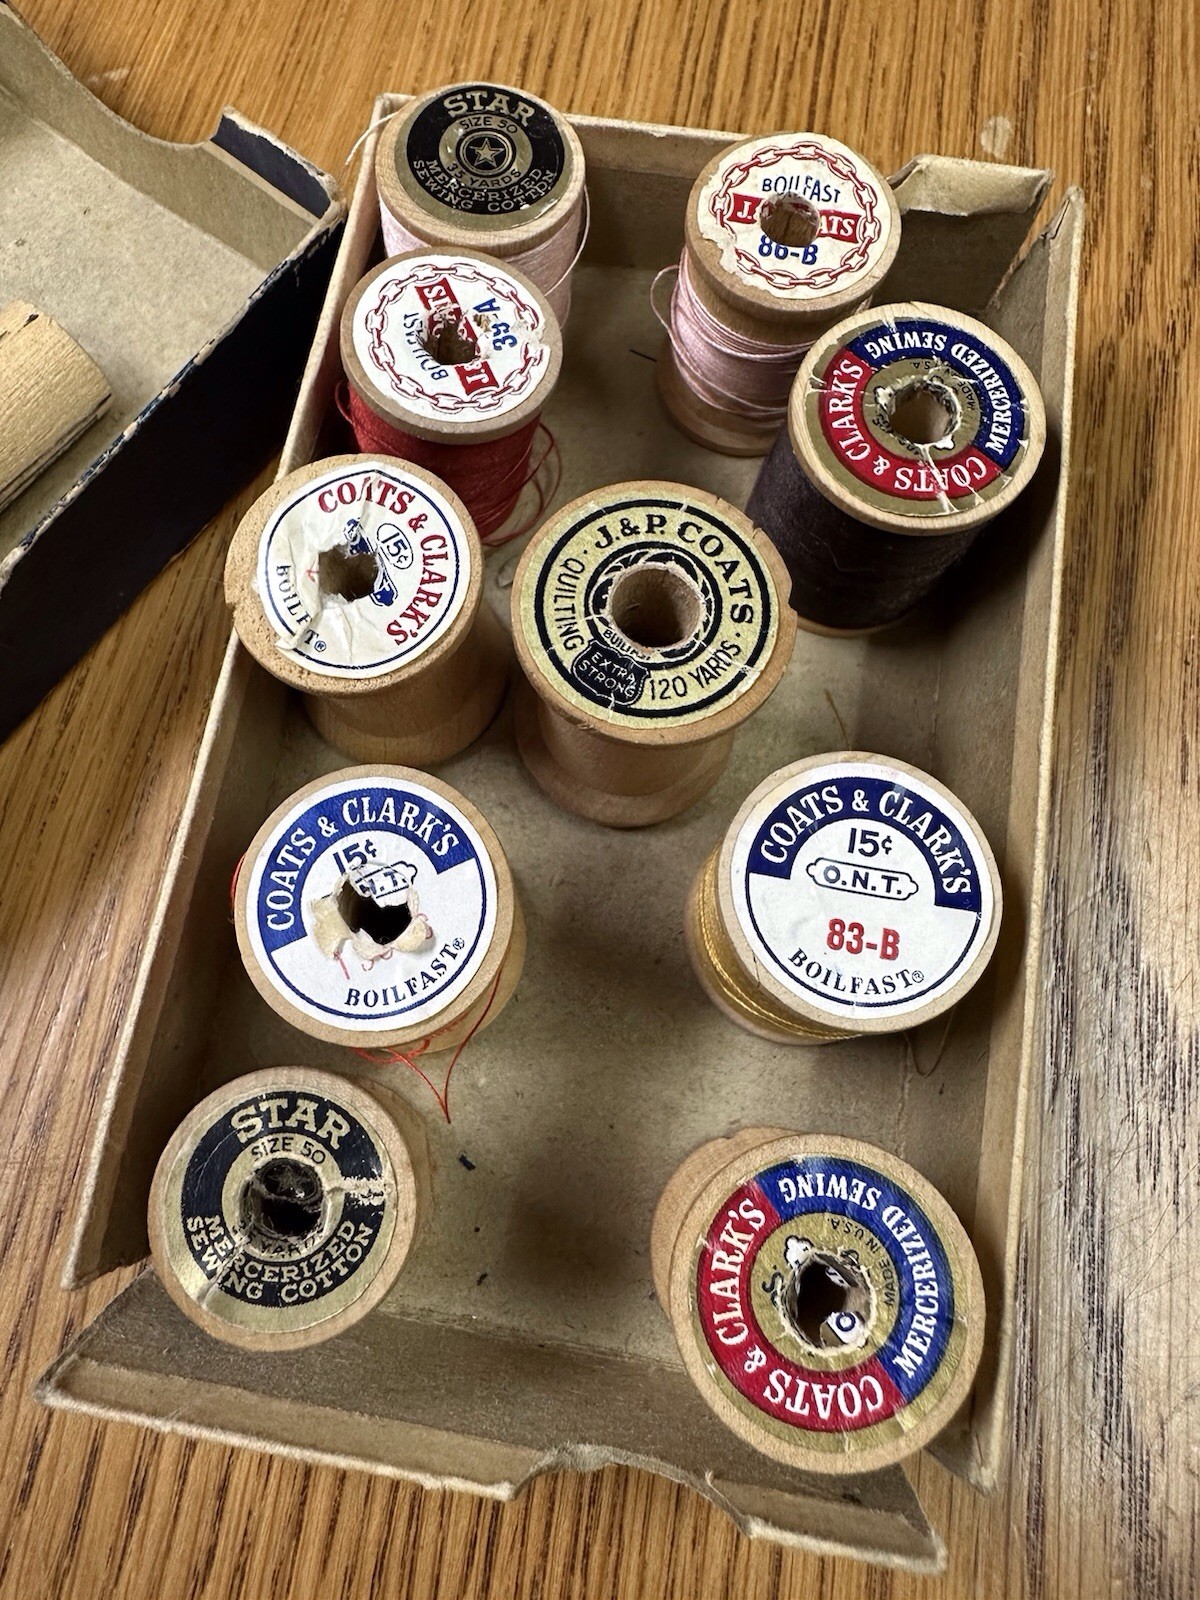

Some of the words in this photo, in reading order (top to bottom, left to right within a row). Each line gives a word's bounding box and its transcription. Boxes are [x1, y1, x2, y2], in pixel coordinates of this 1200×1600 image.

[443, 90, 536, 127] STAR
[459, 116, 492, 130] SIZE
[497, 119, 518, 134] 50
[412, 159, 474, 209] SEWING
[487, 169, 558, 212] COTTON
[426, 159, 543, 201] MERCERIZED
[469, 167, 522, 188] YARDS
[863, 330, 948, 360] SEWING
[828, 358, 871, 462] CLARK'S
[950, 343, 1012, 455] MERCERIZED
[872, 455, 891, 476] &
[893, 456, 987, 492] COATS
[317, 475, 416, 514] COATS
[408, 512, 428, 534] &
[386, 534, 450, 646] CLARK'S
[676, 520, 755, 624] COATS
[554, 557, 586, 651] QUILTING
[578, 659, 637, 698] STRONG
[590, 651, 637, 687] EXTRA
[649, 675, 689, 700] 120
[688, 640, 742, 689] YARDS
[759, 784, 844, 864] COATS
[851, 788, 870, 813] &
[878, 789, 972, 896] CLARK'S
[265, 828, 317, 932] COATS
[316, 815, 340, 839] &
[341, 796, 460, 857] CLARK'S
[822, 864, 903, 895] O.N.T.
[826, 917, 901, 961] 83-B
[230, 1097, 352, 1150] STAR
[251, 1136, 294, 1162] SIZE
[300, 1142, 326, 1165] 50
[778, 1172, 882, 1211] SEWING
[203, 1214, 356, 1283] MERCERIZED
[827, 1217, 865, 1240] U.S.A.
[865, 1237, 881, 1254] IN
[280, 1222, 374, 1302] COTTON
[709, 1197, 766, 1347] CLARK'S
[878, 1257, 897, 1307] MADE
[881, 1204, 940, 1379] MERCERIZED
[743, 1344, 768, 1374] &
[763, 1368, 884, 1420] COATS
